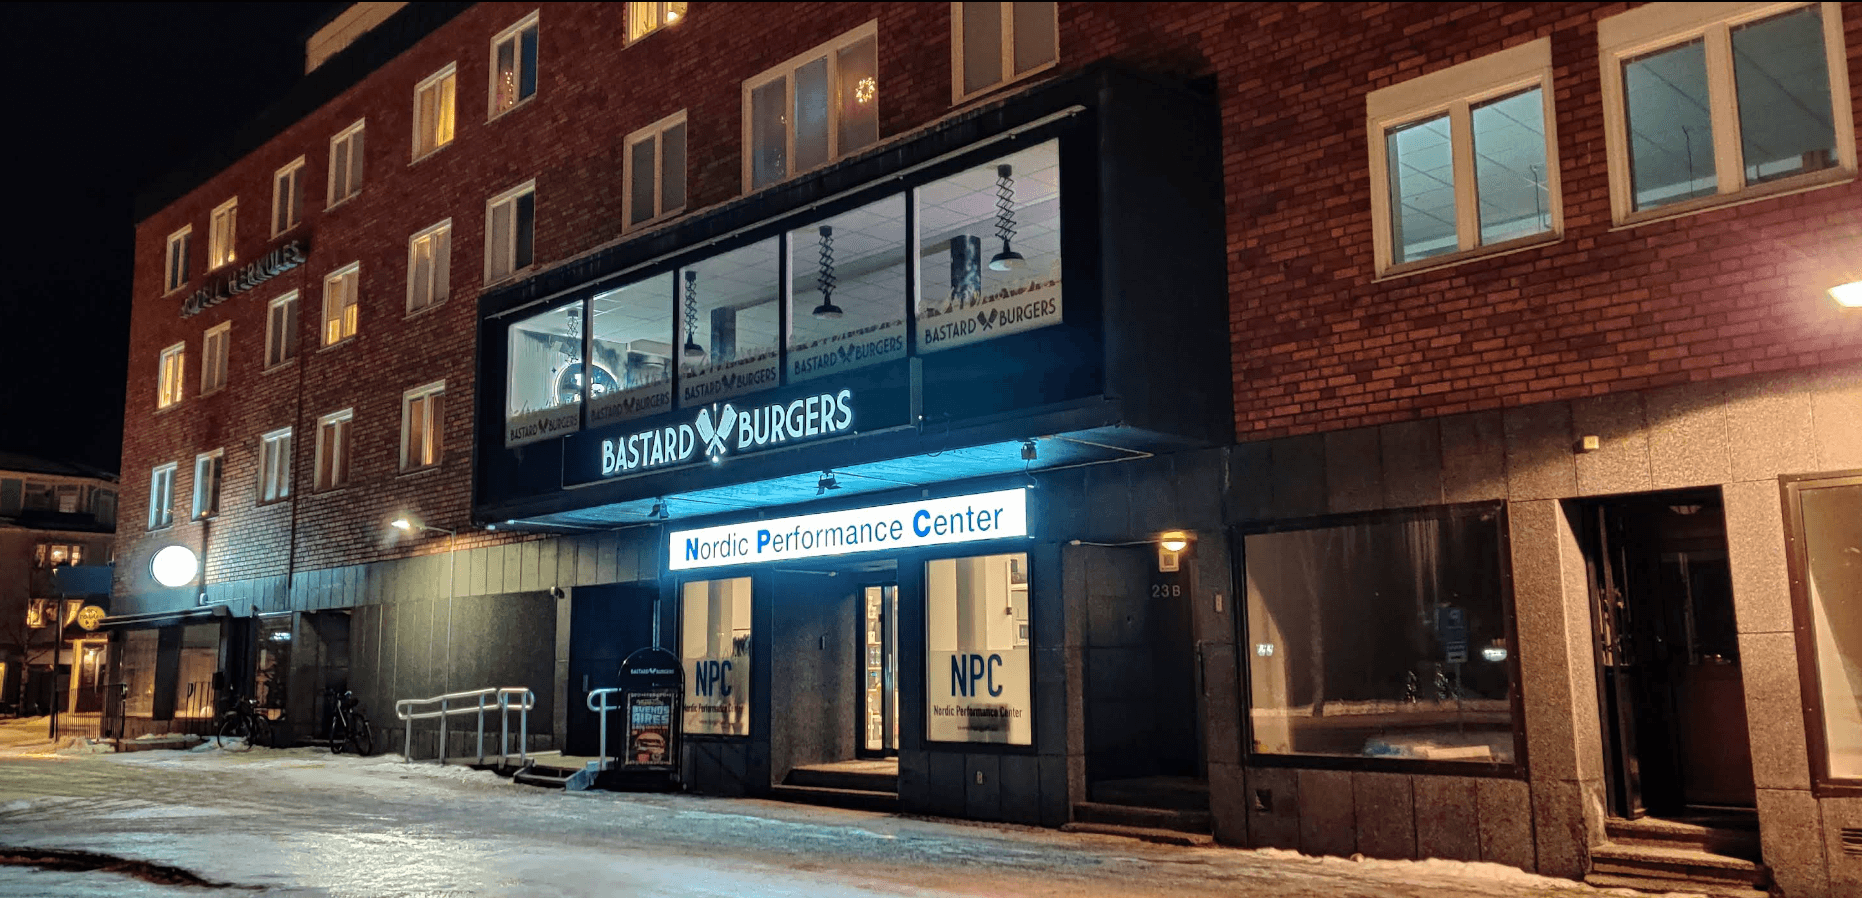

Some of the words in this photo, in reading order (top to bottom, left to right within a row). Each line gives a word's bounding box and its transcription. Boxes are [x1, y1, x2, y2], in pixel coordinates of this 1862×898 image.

[228, 240, 307, 295] HERKULES
[924, 317, 977, 345] BASTARD
[999, 297, 1057, 327] BURGERS
[794, 352, 838, 376] BASTARD
[855, 335, 903, 360] BURGERS
[684, 380, 722, 401] BASTARD
[736, 367, 777, 389] BURGERS
[590, 402, 623, 423] BASTARD
[635, 391, 670, 412] BURGERS
[510, 422, 538, 441] BASTARD
[548, 413, 578, 433] BURGERS
[601, 424, 695, 476] BASTARD
[737, 389, 853, 449] BURGERS
[685, 532, 749, 562] Nordic
[757, 519, 904, 554] Performance
[912, 505, 1005, 538] Center
[695, 659, 733, 697] NPC
[950, 653, 1004, 698] NPC
[632, 705, 670, 715] BUENOS
[632, 713, 670, 725] AIRES
[684, 703, 697, 713] ordic
[933, 704, 955, 717] Nordic
[956, 705, 998, 718] Performance
[999, 706, 1023, 719] Center
